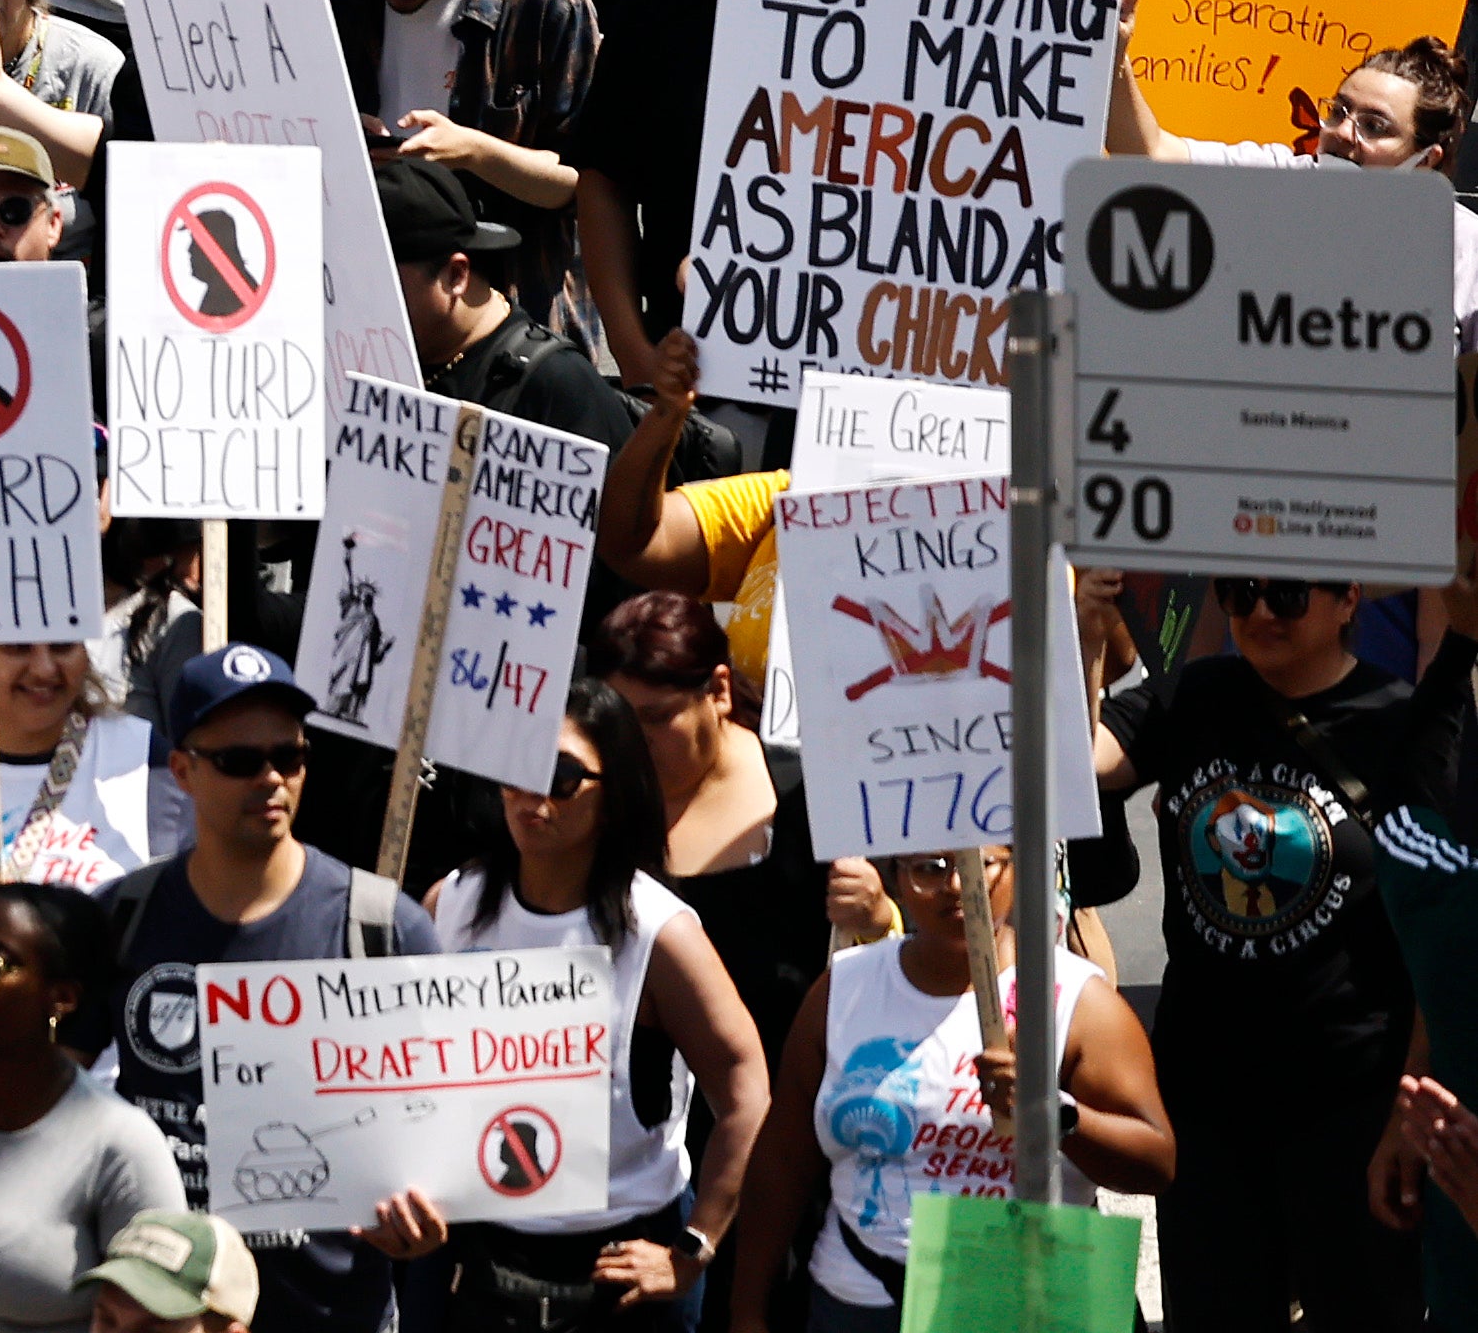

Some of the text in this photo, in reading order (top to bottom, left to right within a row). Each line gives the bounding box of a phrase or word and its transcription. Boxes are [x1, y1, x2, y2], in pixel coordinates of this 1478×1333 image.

[758, 3, 1093, 128] TO MAKE
[726, 87, 1034, 208] AMERICA
[1237, 292, 1433, 354] Metro
[1086, 389, 1349, 453] 4 Santa Monica
[1083, 477, 1376, 542] 90 North Hollywood
[207, 960, 598, 1027] NO MILITARY Parade
[213, 1024, 606, 1087] For DRAFT DODGER
